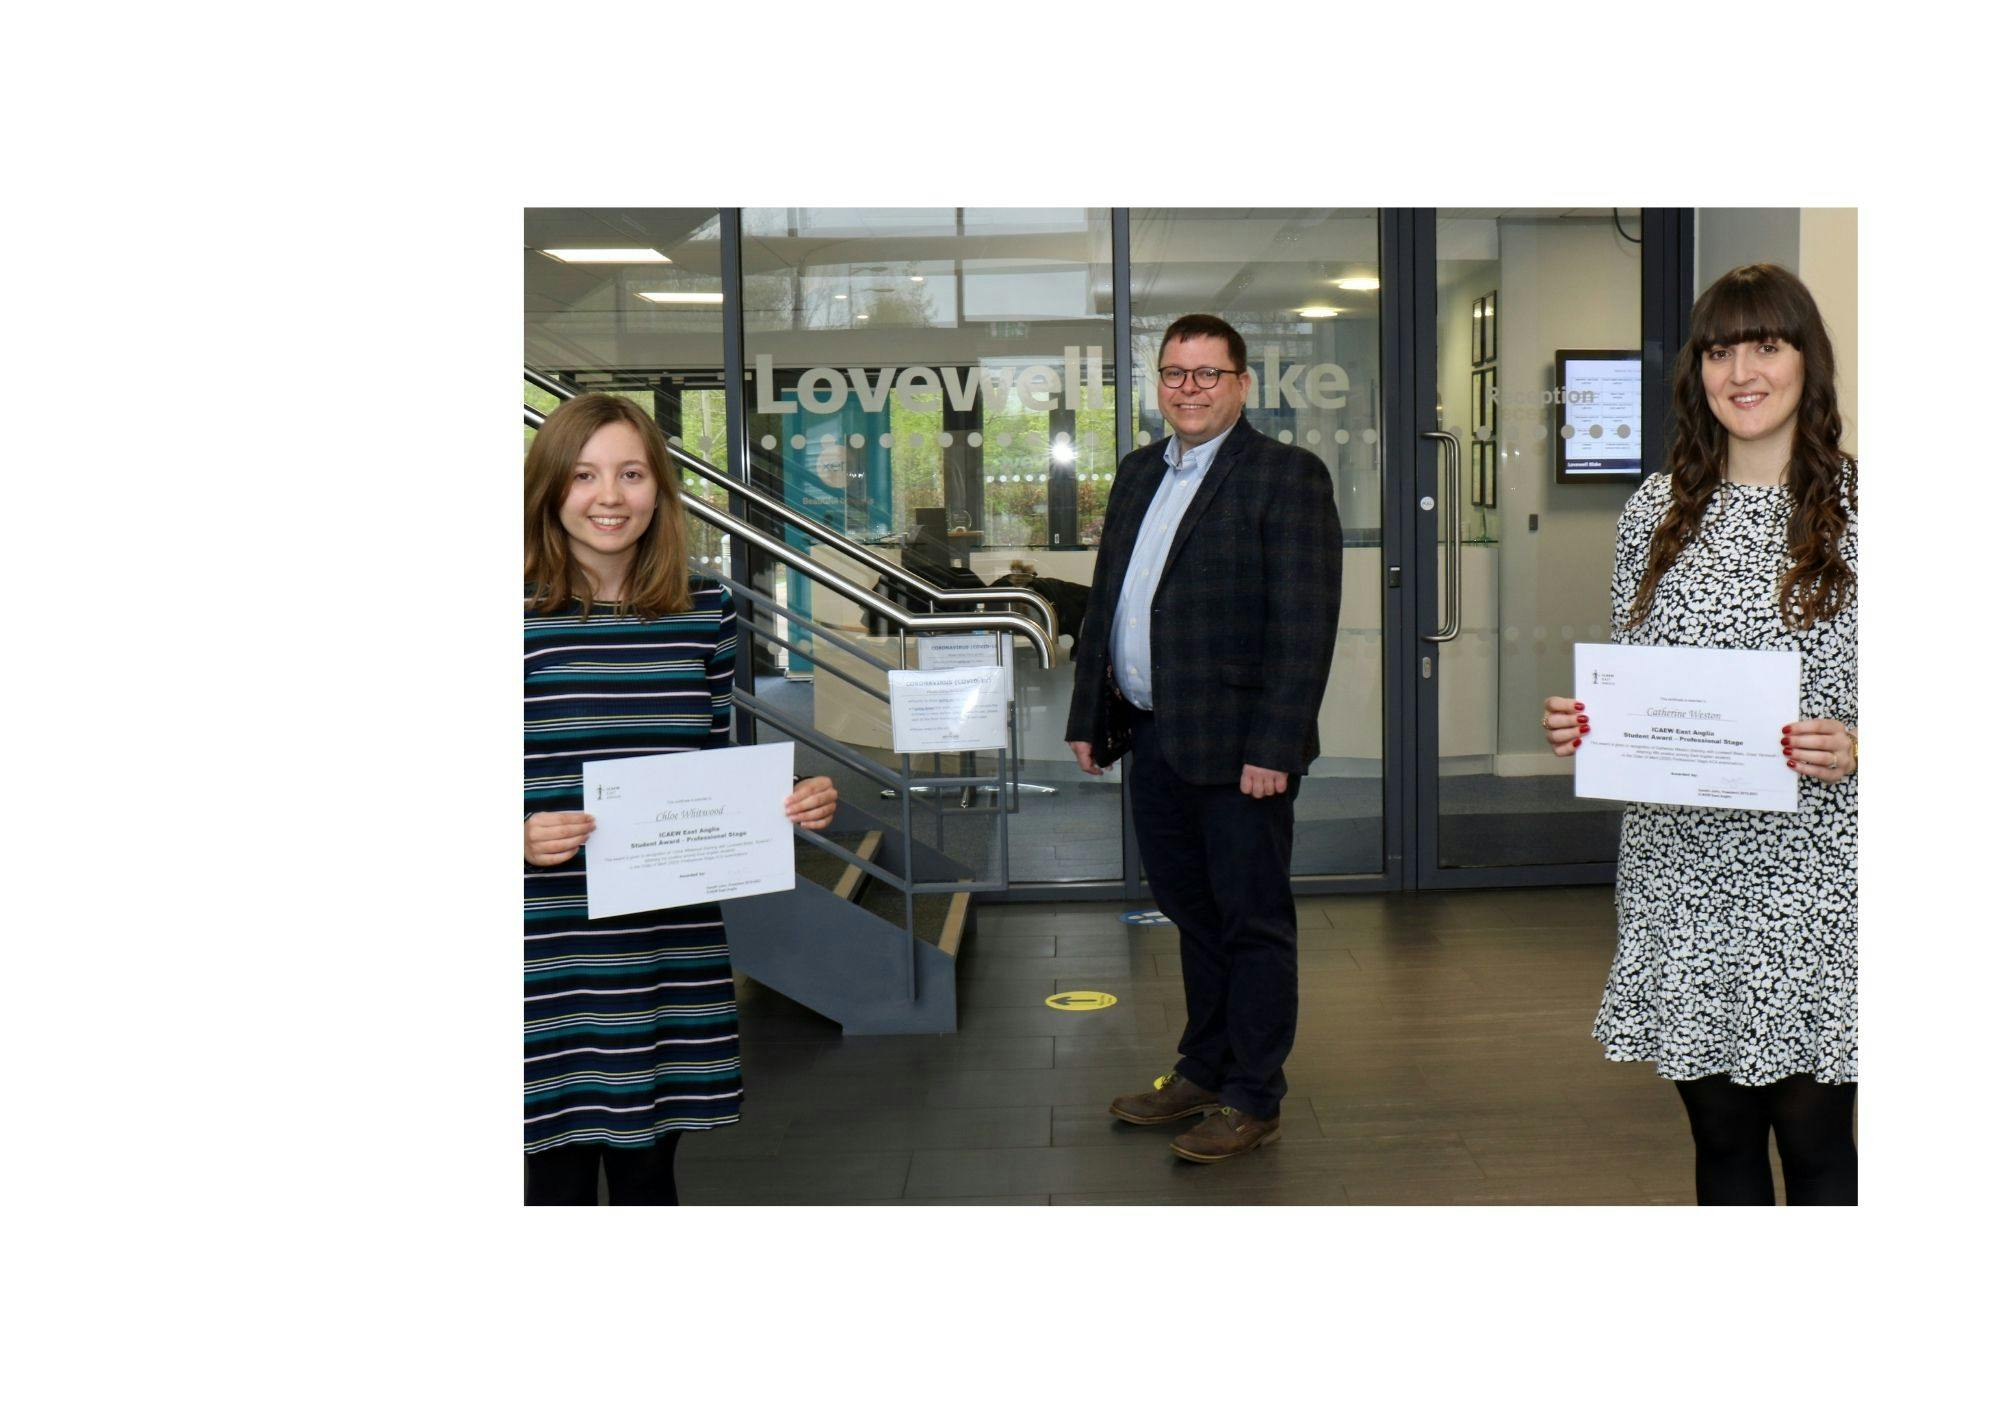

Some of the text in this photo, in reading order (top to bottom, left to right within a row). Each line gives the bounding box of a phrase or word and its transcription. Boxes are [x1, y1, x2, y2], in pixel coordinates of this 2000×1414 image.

[755, 345, 1105, 415] Lovewell
[1489, 385, 1594, 409] Reception
[1646, 707, 1722, 720] Catherine Weston
[1679, 736, 1722, 744] Professional
[655, 808, 679, 822] Chloe
[659, 830, 681, 838] ICAEW
[699, 826, 720, 834] Anglia
[630, 841, 657, 849] Student
[658, 838, 680, 846] Award
[686, 832, 727, 843] Professional
